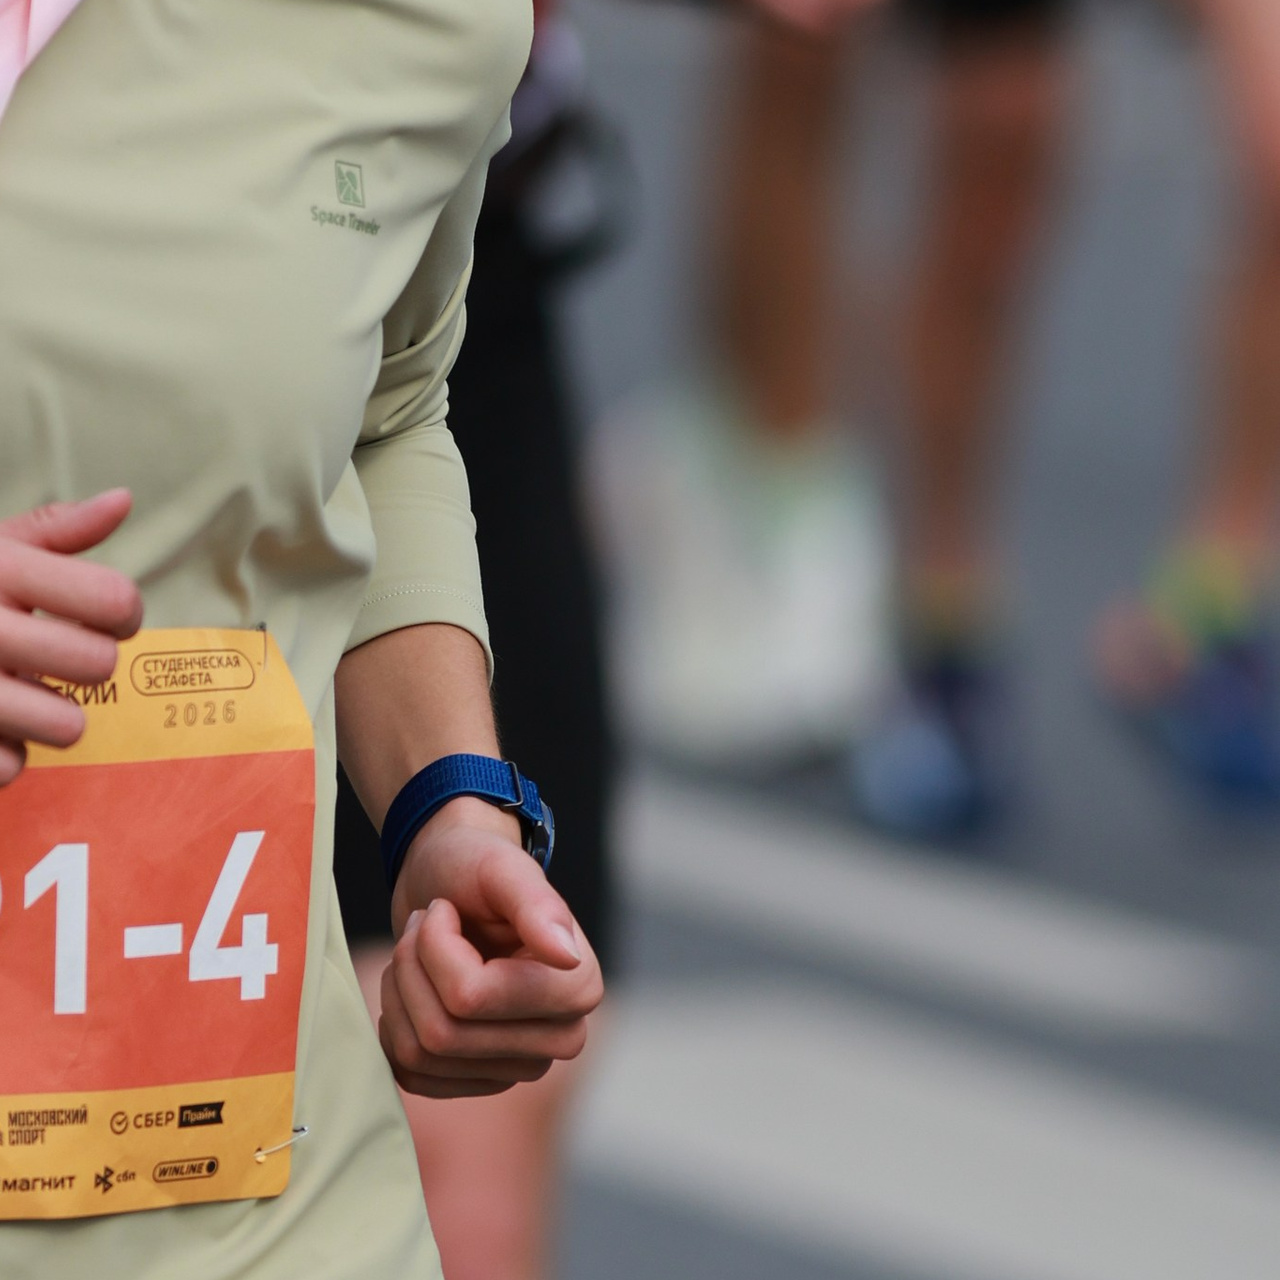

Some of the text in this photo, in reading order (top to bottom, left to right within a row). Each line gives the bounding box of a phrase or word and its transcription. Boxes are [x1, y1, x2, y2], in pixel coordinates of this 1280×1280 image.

[310, 205, 346, 228] Space
[143, 654, 241, 674] СТУДЕНЧЕСКАЯ
[144, 673, 213, 690] ЭСТАФЕТА
[163, 700, 236, 729] 2026
[8, 1104, 88, 1127] МОСКОВСКИЙ
[133, 1107, 217, 1130] СБЕР Прайм
[8, 1128, 46, 1146] СПОРТ
[157, 1161, 205, 1178] WINLINE
